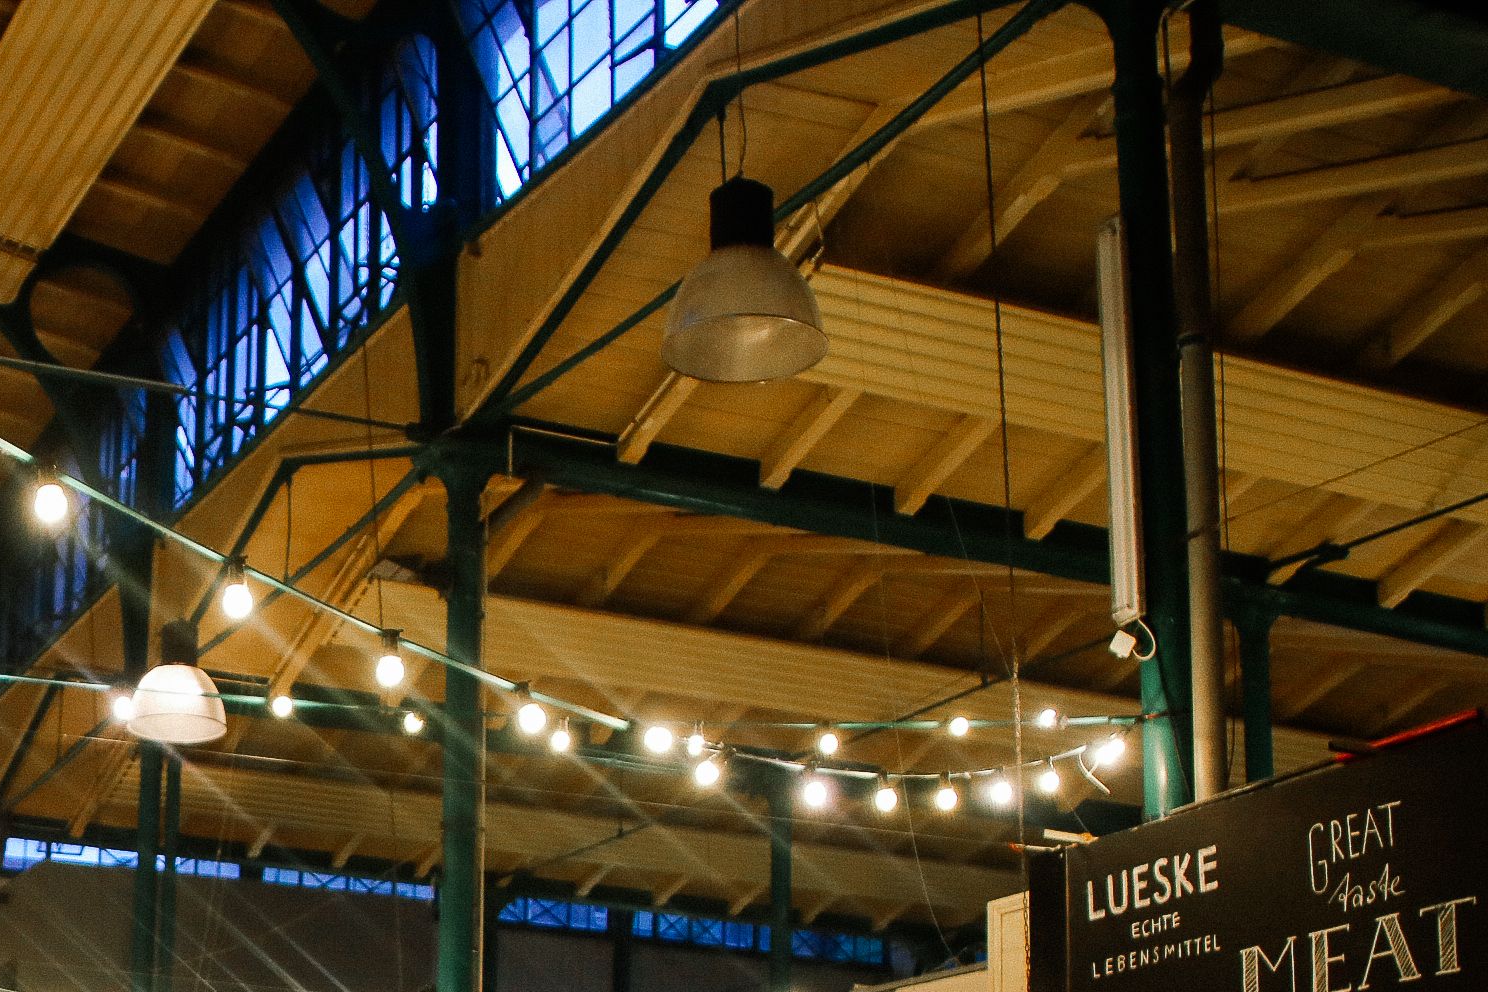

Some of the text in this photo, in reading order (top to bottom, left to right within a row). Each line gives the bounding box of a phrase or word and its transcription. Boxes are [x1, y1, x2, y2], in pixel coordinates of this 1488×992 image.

[1308, 801, 1401, 894] GREAT
[1087, 845, 1218, 921] LUESKE
[1329, 863, 1407, 912] taste
[1131, 911, 1181, 939] ECHTE
[1092, 934, 1221, 979] LEBENSMITTEL
